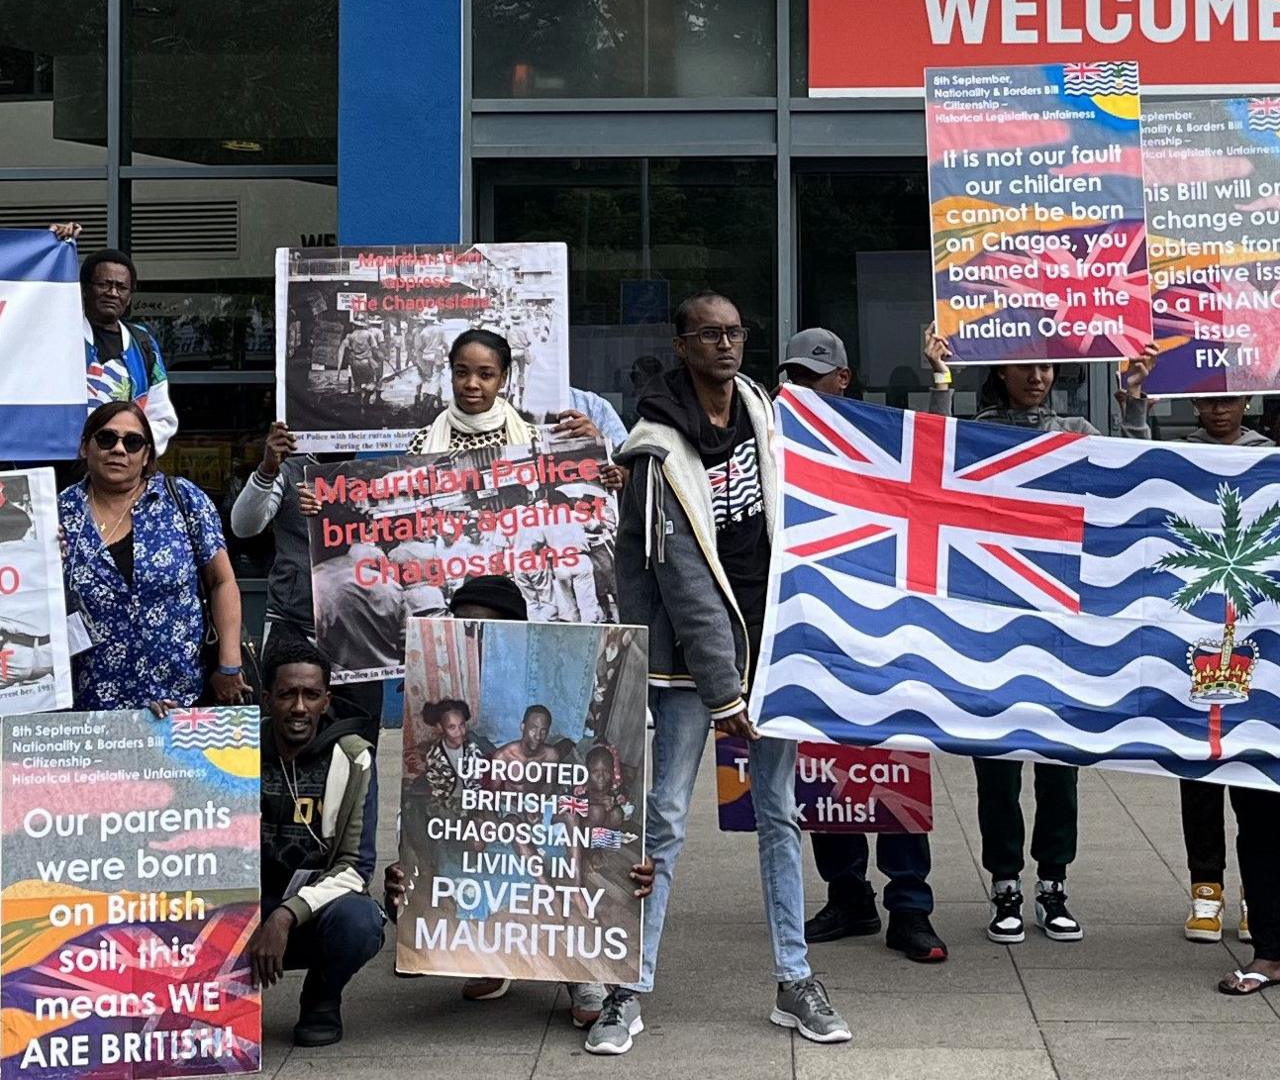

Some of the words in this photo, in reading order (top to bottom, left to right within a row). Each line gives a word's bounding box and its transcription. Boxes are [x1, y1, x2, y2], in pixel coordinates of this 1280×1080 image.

[943, 150, 956, 168] It
[963, 148, 979, 167] is
[987, 148, 1021, 167] not
[1029, 148, 1065, 166] our
[1071, 144, 1121, 164] fault
[965, 179, 1002, 196] our
[1009, 175, 1102, 194] children
[1177, 182, 1208, 200] Bill
[1214, 179, 1251, 199] will
[946, 205, 1028, 225] cannot
[1034, 203, 1064, 222] be
[1071, 202, 1124, 220] born
[1152, 210, 1243, 232] change
[946, 236, 974, 253] on
[982, 232, 1077, 254] Chagos,
[1084, 231, 1127, 251] you
[949, 263, 1038, 281] banned
[1046, 263, 1069, 279] us
[1076, 259, 1128, 277] from
[950, 294, 986, 310] our
[994, 291, 1060, 309] home
[1067, 290, 1086, 308] in
[1092, 288, 1129, 306] the
[1176, 296, 1191, 313] a
[959, 318, 1031, 339] Indian
[1038, 315, 1124, 337] Ocean!
[1194, 319, 1257, 340] issue.
[1196, 348, 1229, 369] FIX
[1238, 348, 1260, 366] IT!
[314, 466, 480, 504] Mauritian
[492, 457, 600, 487] Police
[322, 508, 466, 548] brutality
[477, 498, 605, 538] against
[354, 543, 579, 588] Chagossians
[458, 756, 589, 785] UPROOTED
[799, 757, 838, 783] UK
[848, 762, 910, 783] can
[462, 789, 559, 815] BRITISH
[816, 796, 875, 823] this!
[24, 808, 88, 839] Our
[100, 800, 231, 841] parents
[427, 818, 590, 848] CHAGOSSIAN
[36, 858, 125, 883] were
[138, 849, 217, 880] born
[462, 851, 543, 878] LIVING
[551, 857, 576, 879] IN
[49, 903, 93, 928] on
[107, 890, 205, 925] British
[431, 877, 605, 919] POVERTY
[415, 917, 628, 960] MAURITIUS
[59, 940, 128, 973] soil,
[137, 937, 196, 969] this
[35, 990, 164, 1021] means
[168, 981, 221, 1014] WE
[20, 1035, 89, 1070] ARE
[102, 1026, 234, 1063] BRITISH!
